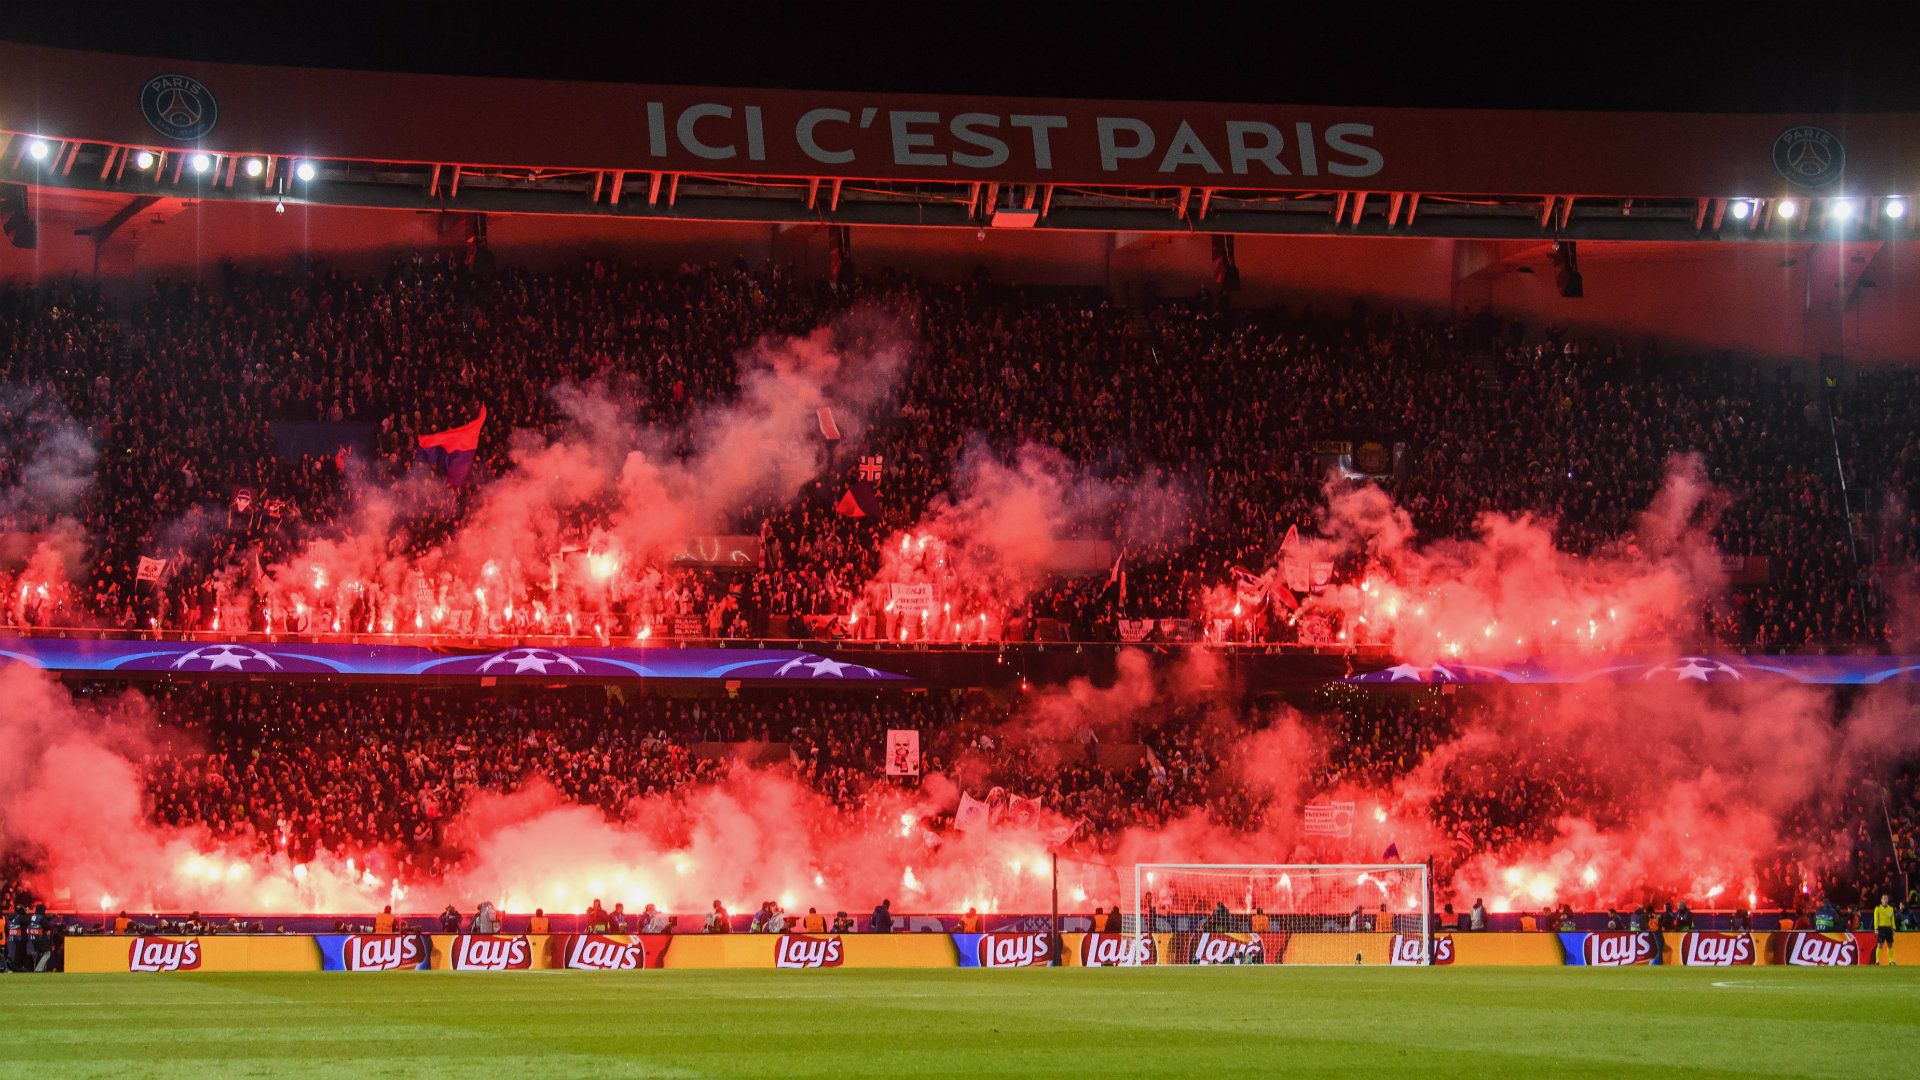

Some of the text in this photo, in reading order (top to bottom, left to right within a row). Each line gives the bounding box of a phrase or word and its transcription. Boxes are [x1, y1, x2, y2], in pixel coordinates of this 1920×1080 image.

[152, 77, 201, 95] PARIS
[647, 102, 1384, 177] ICI C'EST PARIS
[1783, 128, 1831, 145] PARIS
[131, 938, 198, 971] Lay's
[457, 935, 526, 971] Lay's
[569, 935, 640, 970] Lay's
[777, 935, 841, 969] Lay's
[1087, 934, 1152, 967] Lay's
[1391, 934, 1452, 965] La's
[1690, 933, 1749, 966] Lay's
[1790, 933, 1855, 966] Lay's
